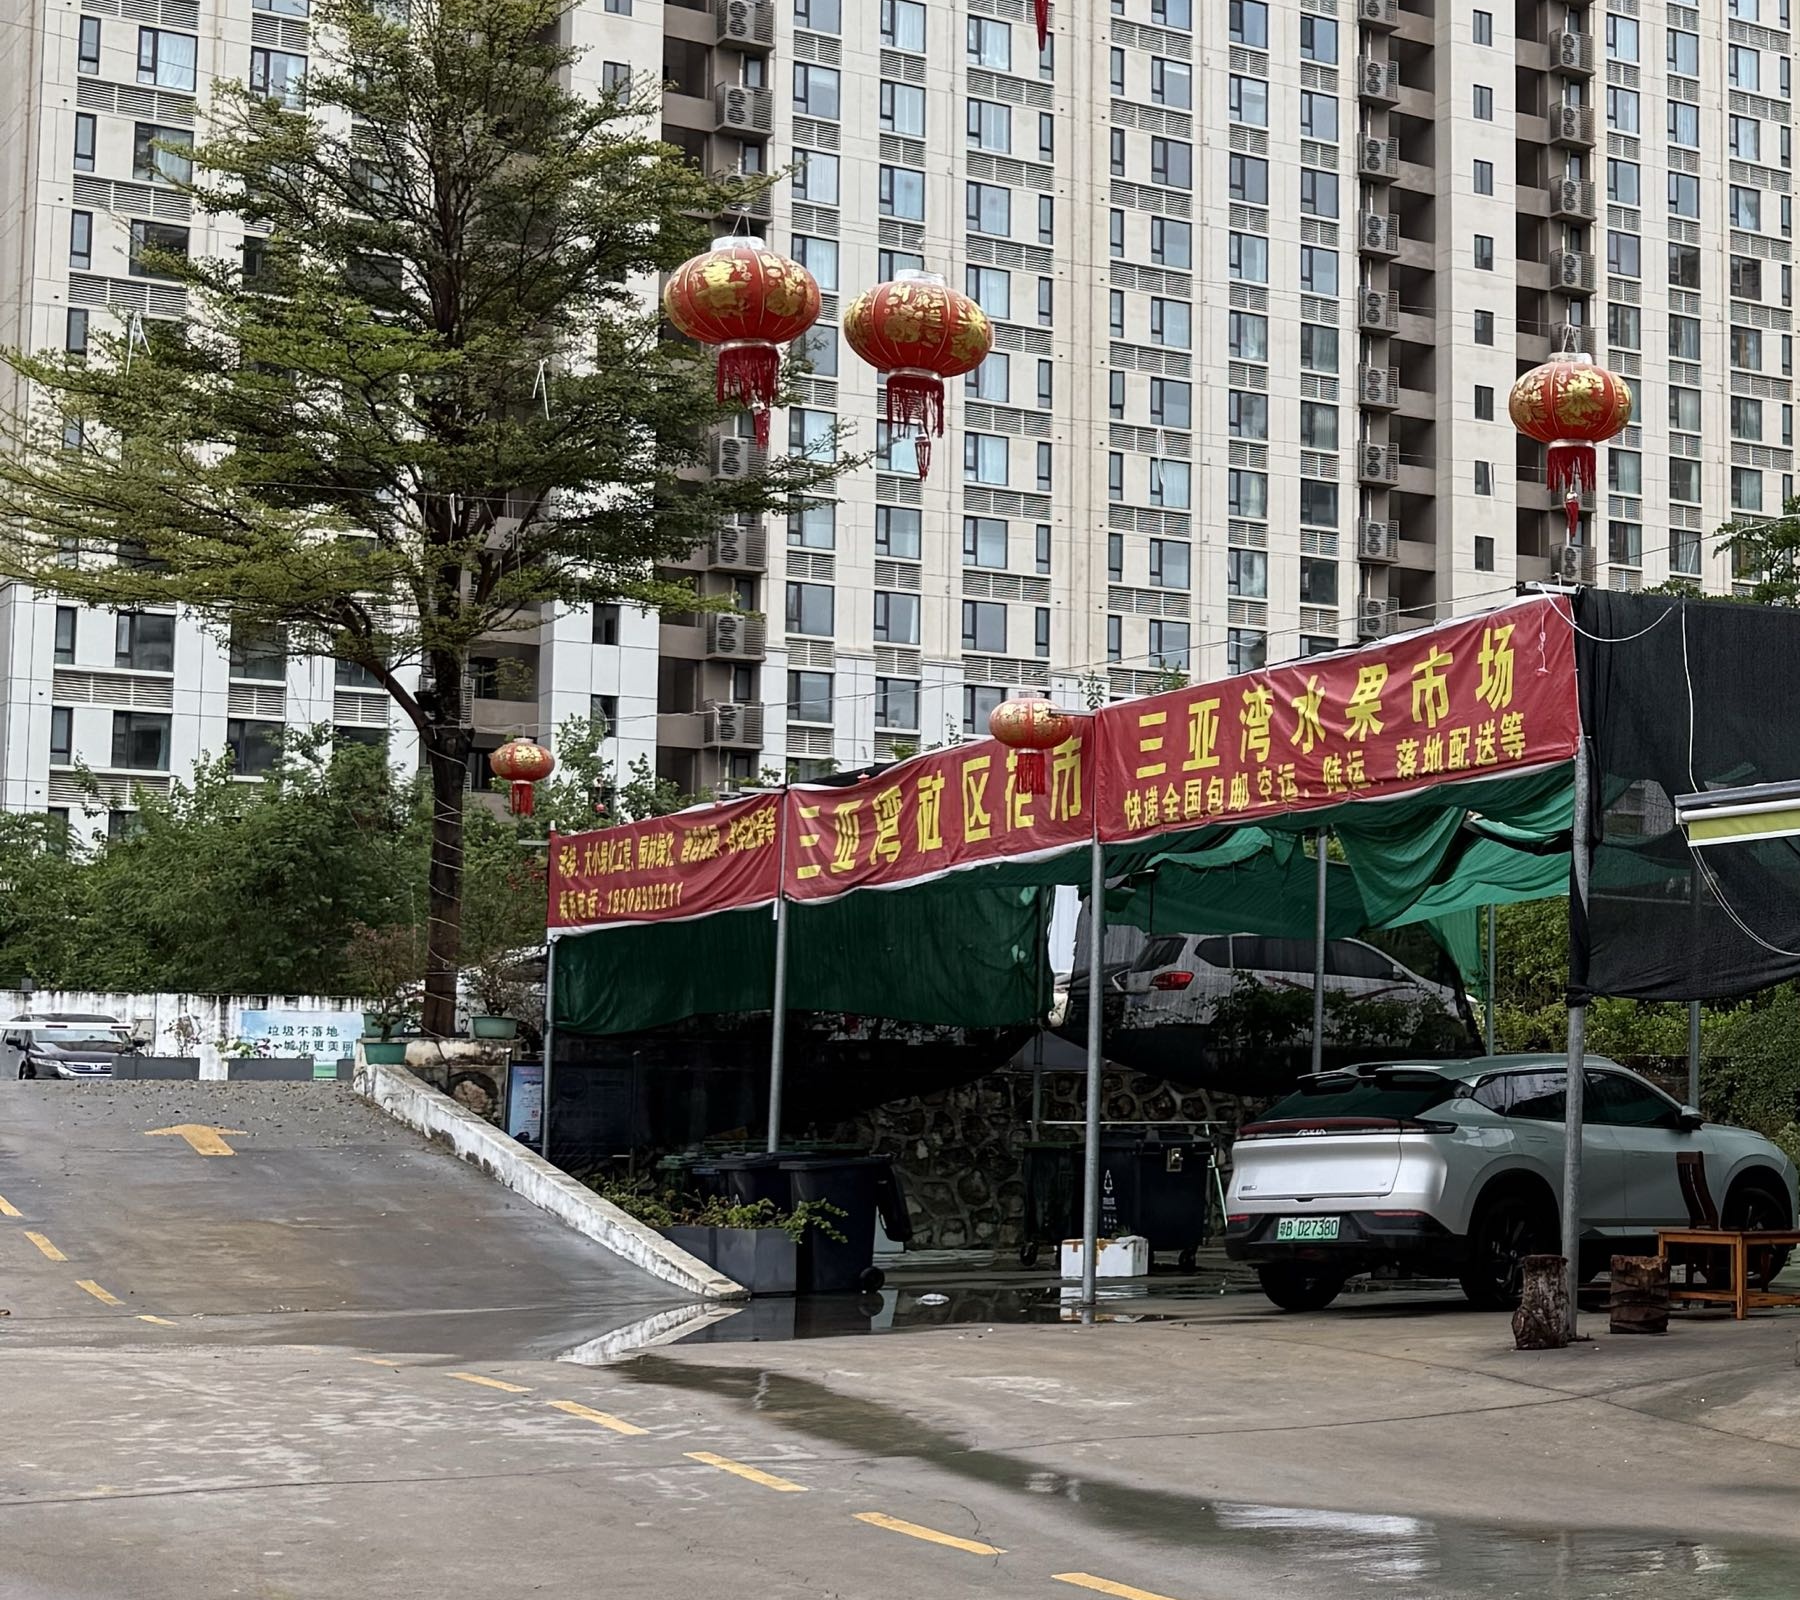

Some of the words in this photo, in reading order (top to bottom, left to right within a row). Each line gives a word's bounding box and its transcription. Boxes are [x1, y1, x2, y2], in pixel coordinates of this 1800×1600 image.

[1137, 624, 1516, 779] 三亚湾水果市场
